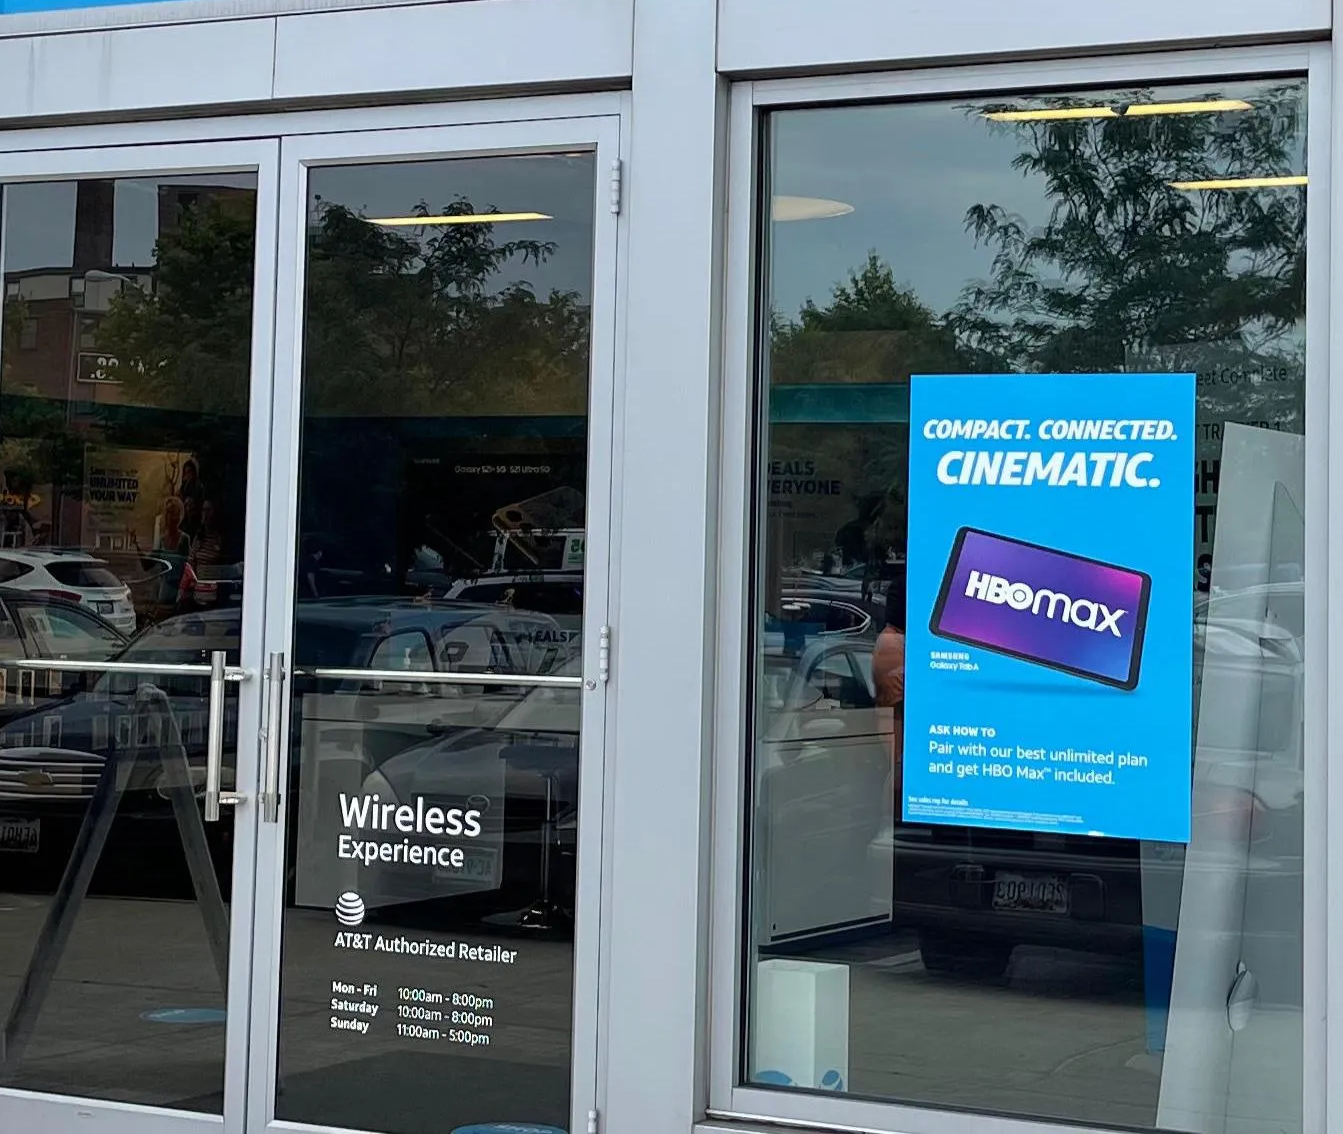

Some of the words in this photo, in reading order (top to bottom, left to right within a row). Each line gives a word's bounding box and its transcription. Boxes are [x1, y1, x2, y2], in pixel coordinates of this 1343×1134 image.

[923, 419, 1031, 440] COMPACT.
[1038, 419, 1178, 441] CONNECTED.
[768, 461, 814, 476] EALS
[936, 450, 1161, 488] CINEMATIC.
[768, 480, 840, 495] ERYONE
[930, 651, 970, 661] SAMSUNG
[930, 660, 958, 671] Galaxy
[929, 725, 950, 736] ASK
[953, 726, 979, 737] HOW
[981, 727, 996, 738] TO
[929, 740, 954, 754] Pair
[958, 742, 987, 757] with
[990, 746, 1013, 759] our
[1016, 746, 1046, 761] best
[1049, 748, 1114, 765] unlimited
[1117, 752, 1148, 769] plan
[928, 761, 953, 775] and
[957, 763, 978, 779] get
[982, 764, 1013, 777] HBO
[1055, 769, 1115, 785] included.
[338, 793, 482, 837] Wireless
[338, 834, 464, 867] Experience
[334, 931, 372, 950] AT&T
[374, 935, 456, 958] Authorized
[458, 943, 517, 965] Retailer
[332, 981, 355, 995] Mon
[363, 983, 378, 997] Fri
[397, 987, 443, 1004] 10:00am
[452, 992, 494, 1011] 8:00pm
[331, 998, 379, 1017] Saturday
[397, 1005, 443, 1022] 10:00am
[451, 1011, 493, 1029] 8:00pm
[330, 1016, 370, 1035] Sunday
[396, 1023, 440, 1041] 11:00am
[449, 1029, 490, 1047] 5:00pm
